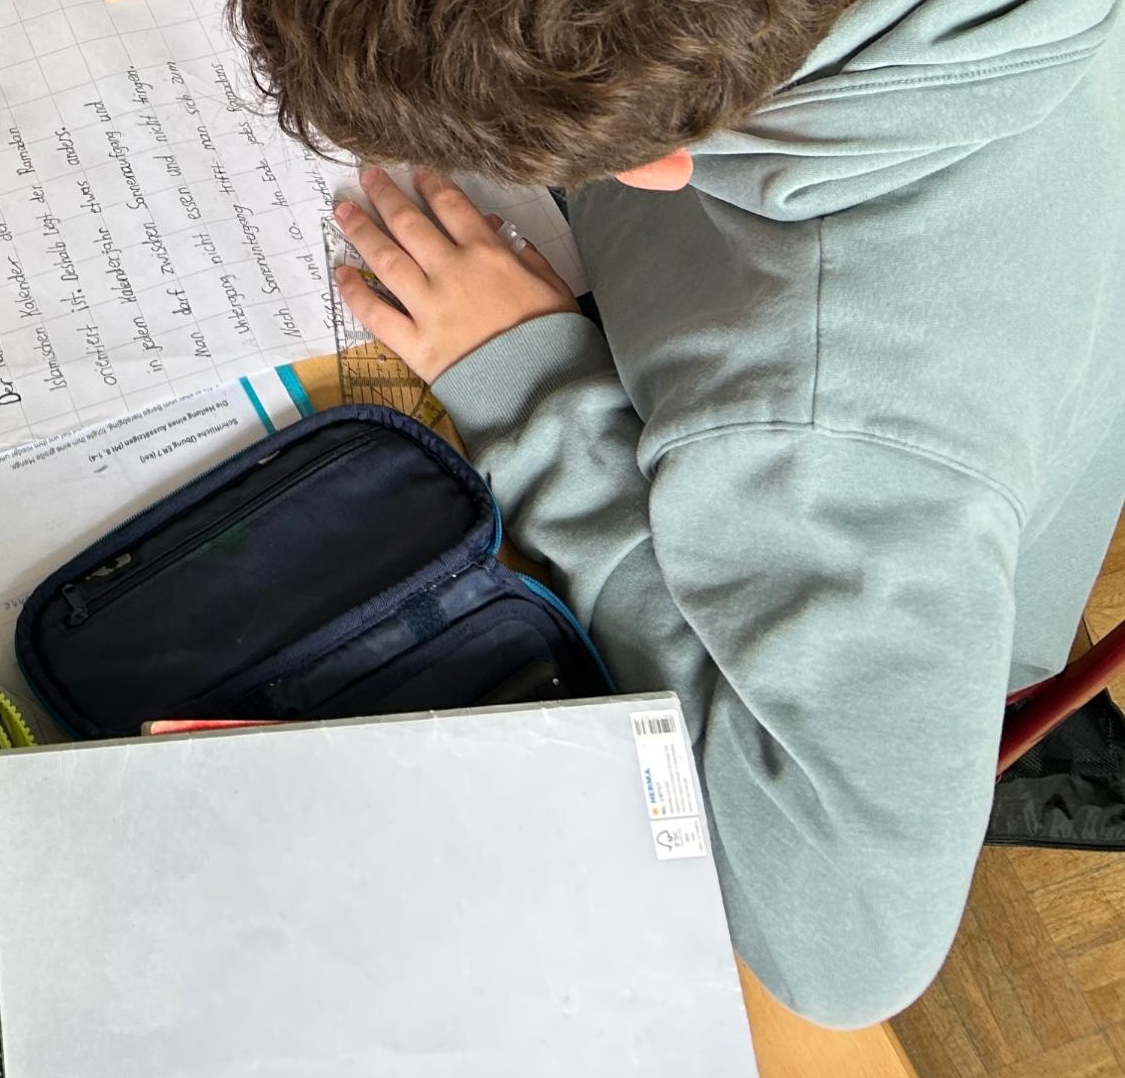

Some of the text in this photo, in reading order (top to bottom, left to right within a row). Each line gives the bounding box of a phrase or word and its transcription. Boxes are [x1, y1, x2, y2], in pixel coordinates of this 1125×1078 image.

[166, 61, 185, 84] zum
[83, 100, 112, 122] und
[176, 94, 200, 115] sich
[139, 115, 168, 142] nicht
[197, 126, 216, 151] man
[8, 127, 35, 176] Ramadan
[105, 131, 148, 210] Sonnenaufgang
[157, 155, 182, 176] und
[211, 162, 235, 195] trifft
[256, 158, 277, 182] Ende
[29, 185, 45, 203] der
[77, 181, 102, 213] etwas
[178, 187, 202, 220] essen
[141, 221, 175, 275] zwischen
[192, 233, 223, 264] nicht
[48, 242, 79, 281] Deshalb
[95, 227, 137, 304] Kalenderjahr
[296, 254, 322, 280] und
[7, 256, 41, 318] Kalender
[166, 289, 192, 315] darf
[220, 274, 250, 334] Untergang
[133, 316, 163, 351] jedem
[275, 308, 302, 338] Nach
[76, 324, 117, 386] orientiert
[190, 332, 211, 358] Man
[33, 327, 67, 391] Islamischen
[147, 359, 163, 373] in
[187, 405, 216, 419] Heilung
[215, 400, 229, 408] Die
[168, 416, 187, 428] eines
[197, 418, 238, 438] Schriftliche
[124, 425, 167, 446] Aussätzigen
[172, 435, 197, 449] Übung
[645, 768, 656, 803] HERMA
